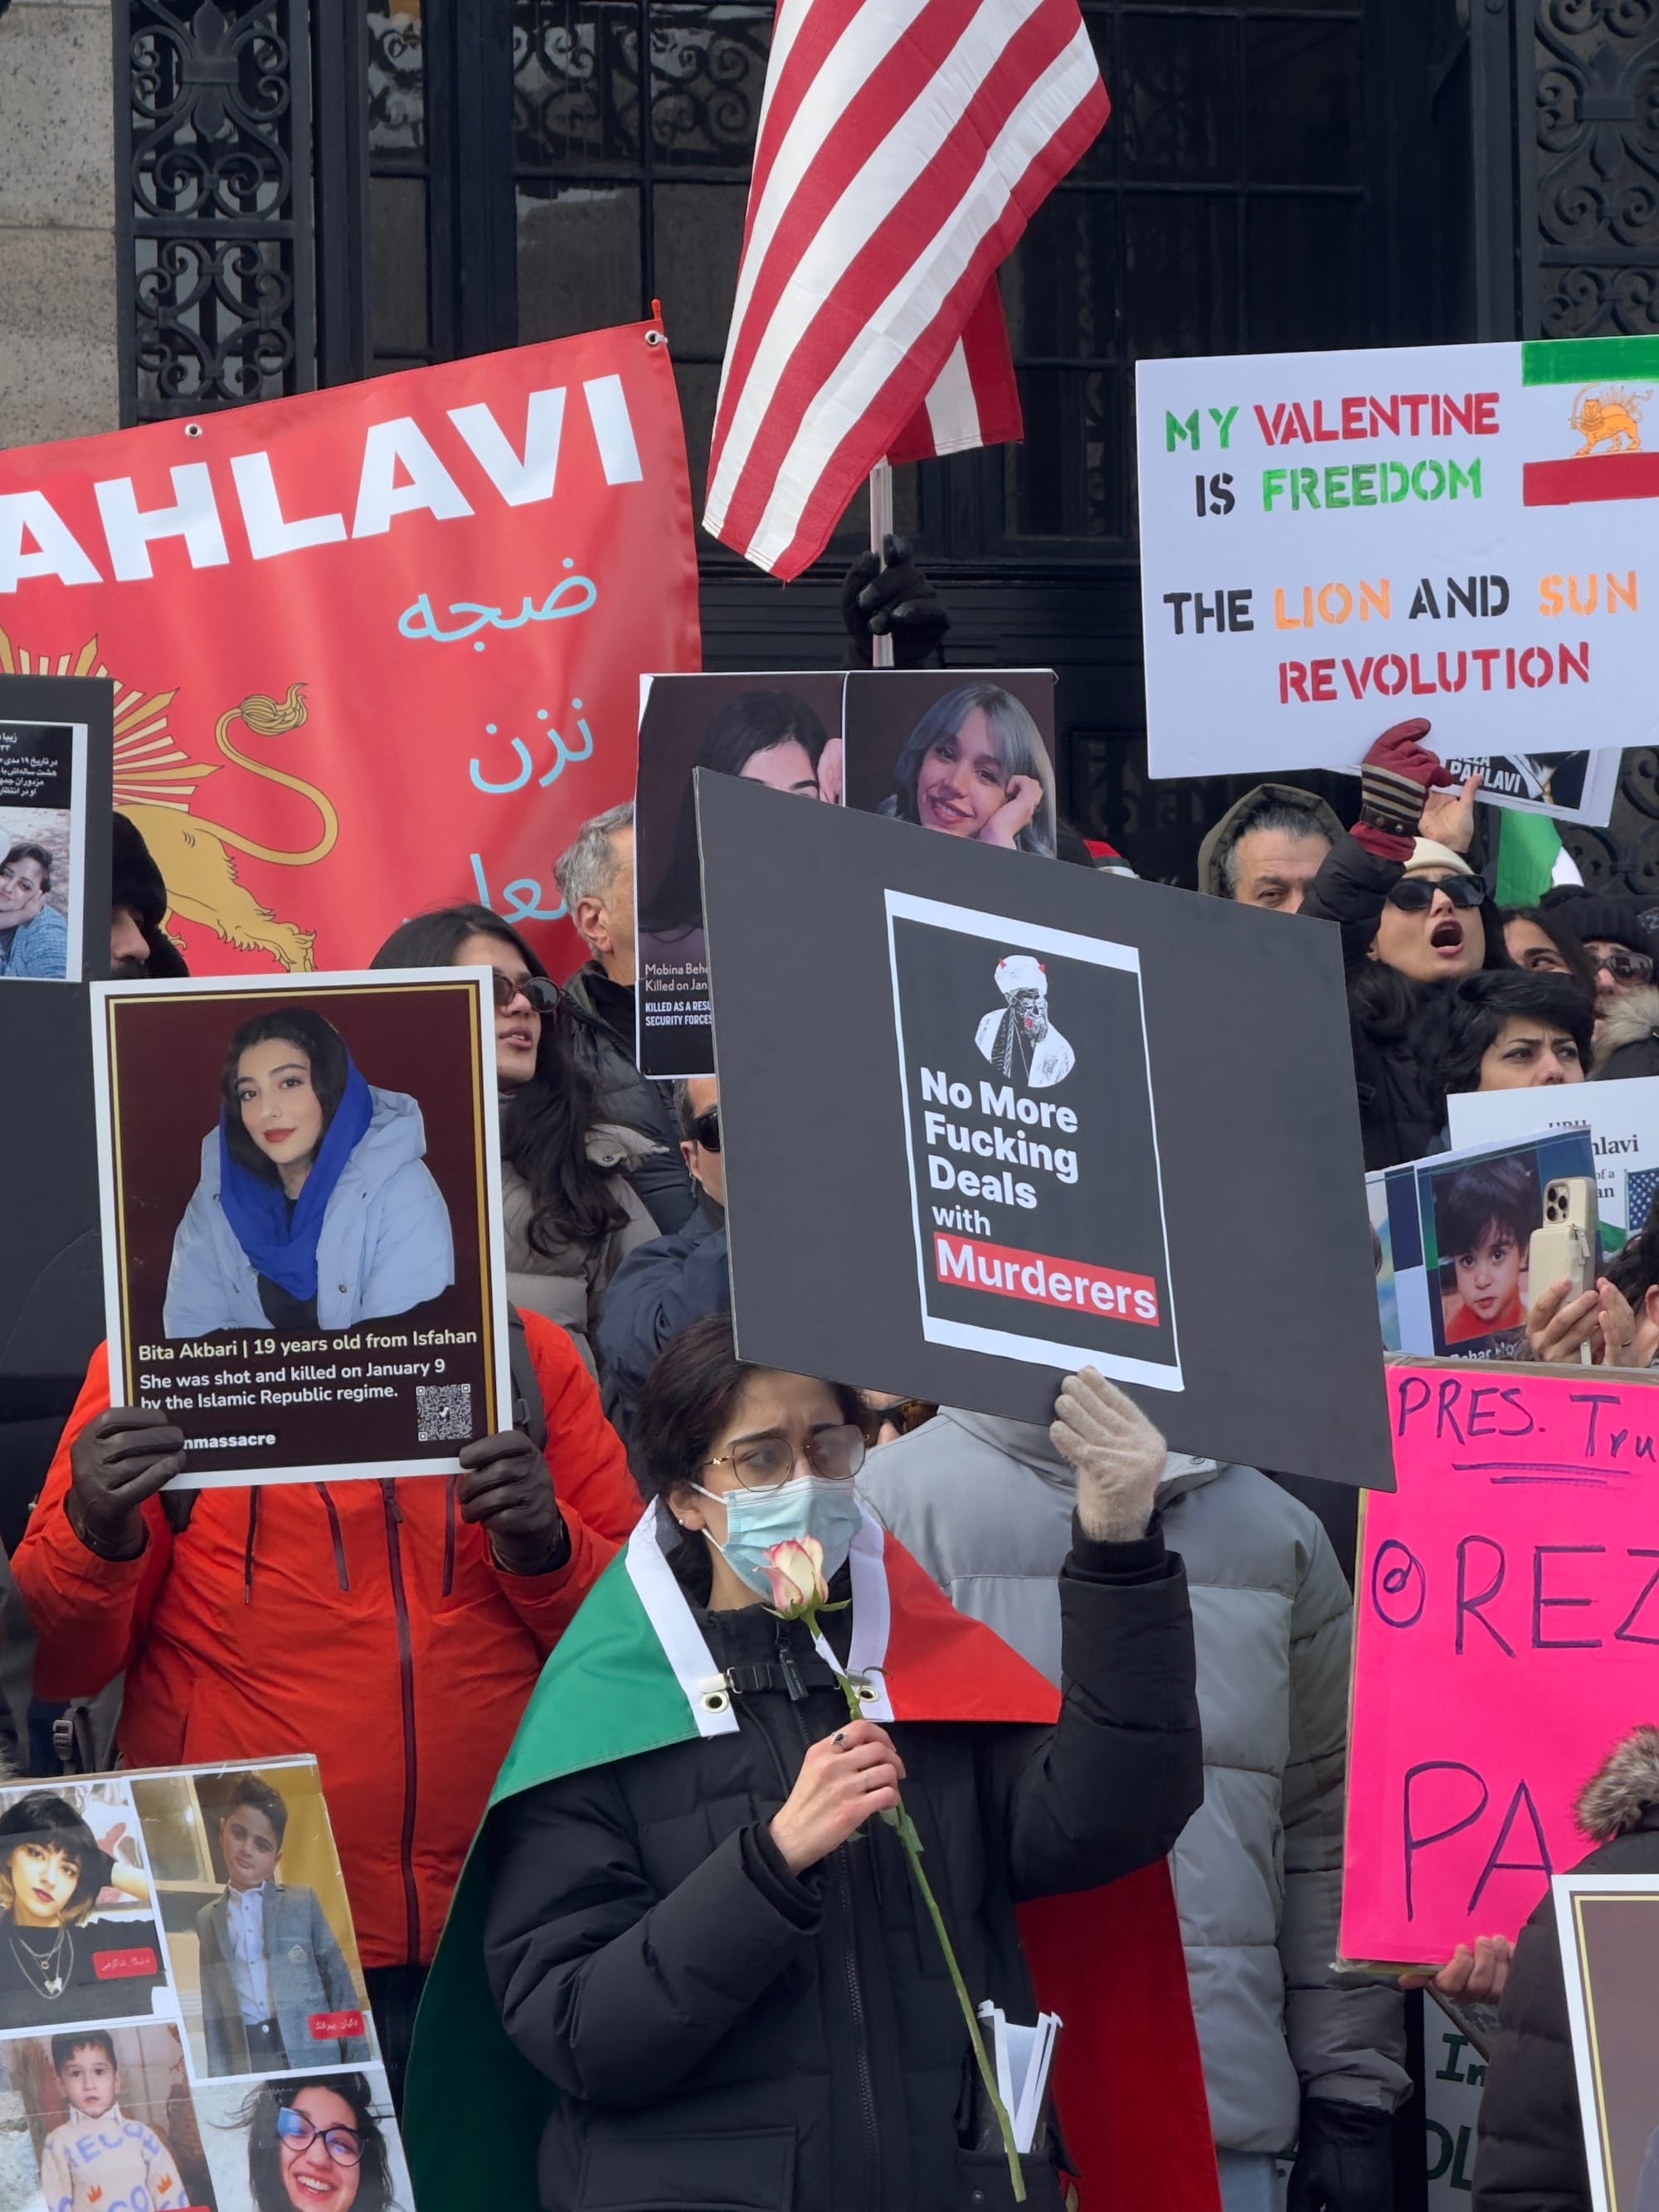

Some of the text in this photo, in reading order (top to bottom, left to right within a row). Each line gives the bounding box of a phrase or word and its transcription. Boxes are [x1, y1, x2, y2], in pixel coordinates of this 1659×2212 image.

[1165, 392, 1500, 452] MY VALENTINE
[1196, 458, 1481, 516] IS FREEDOM
[398, 558, 598, 651] ضجه
[1163, 571, 1637, 634] THE LION AND SUN
[1279, 642, 1589, 703] REVOLUTION
[469, 698, 595, 794] نزن
[645, 963, 684, 975] Mobina
[645, 980, 674, 991] Killed
[645, 1002, 672, 1012] KILLED
[674, 1002, 684, 1012] AS
[685, 1002, 691, 1011] A
[645, 1015, 683, 1026] SECURITY
[921, 1067, 1078, 1133] No More
[924, 1111, 1078, 1184] Fucking
[928, 1155, 1037, 1209] Deals
[932, 1205, 991, 1236] with
[937, 1238, 1156, 1319] Murderers
[139, 1344, 174, 1361] Bita
[179, 1340, 237, 1359] Akbari
[254, 1339, 275, 1354] 19
[280, 1339, 328, 1356] years
[333, 1334, 361, 1349] old
[366, 1332, 407, 1349] from
[413, 1330, 477, 1345] Isfahan
[140, 1359, 445, 1389] She was shot and killed on January 9
[165, 1395, 193, 1409] the
[197, 1391, 255, 1407] Islamic
[260, 1386, 332, 1406] Republic
[337, 1384, 398, 1402] regime.
[1398, 1377, 1545, 1445] PRES.
